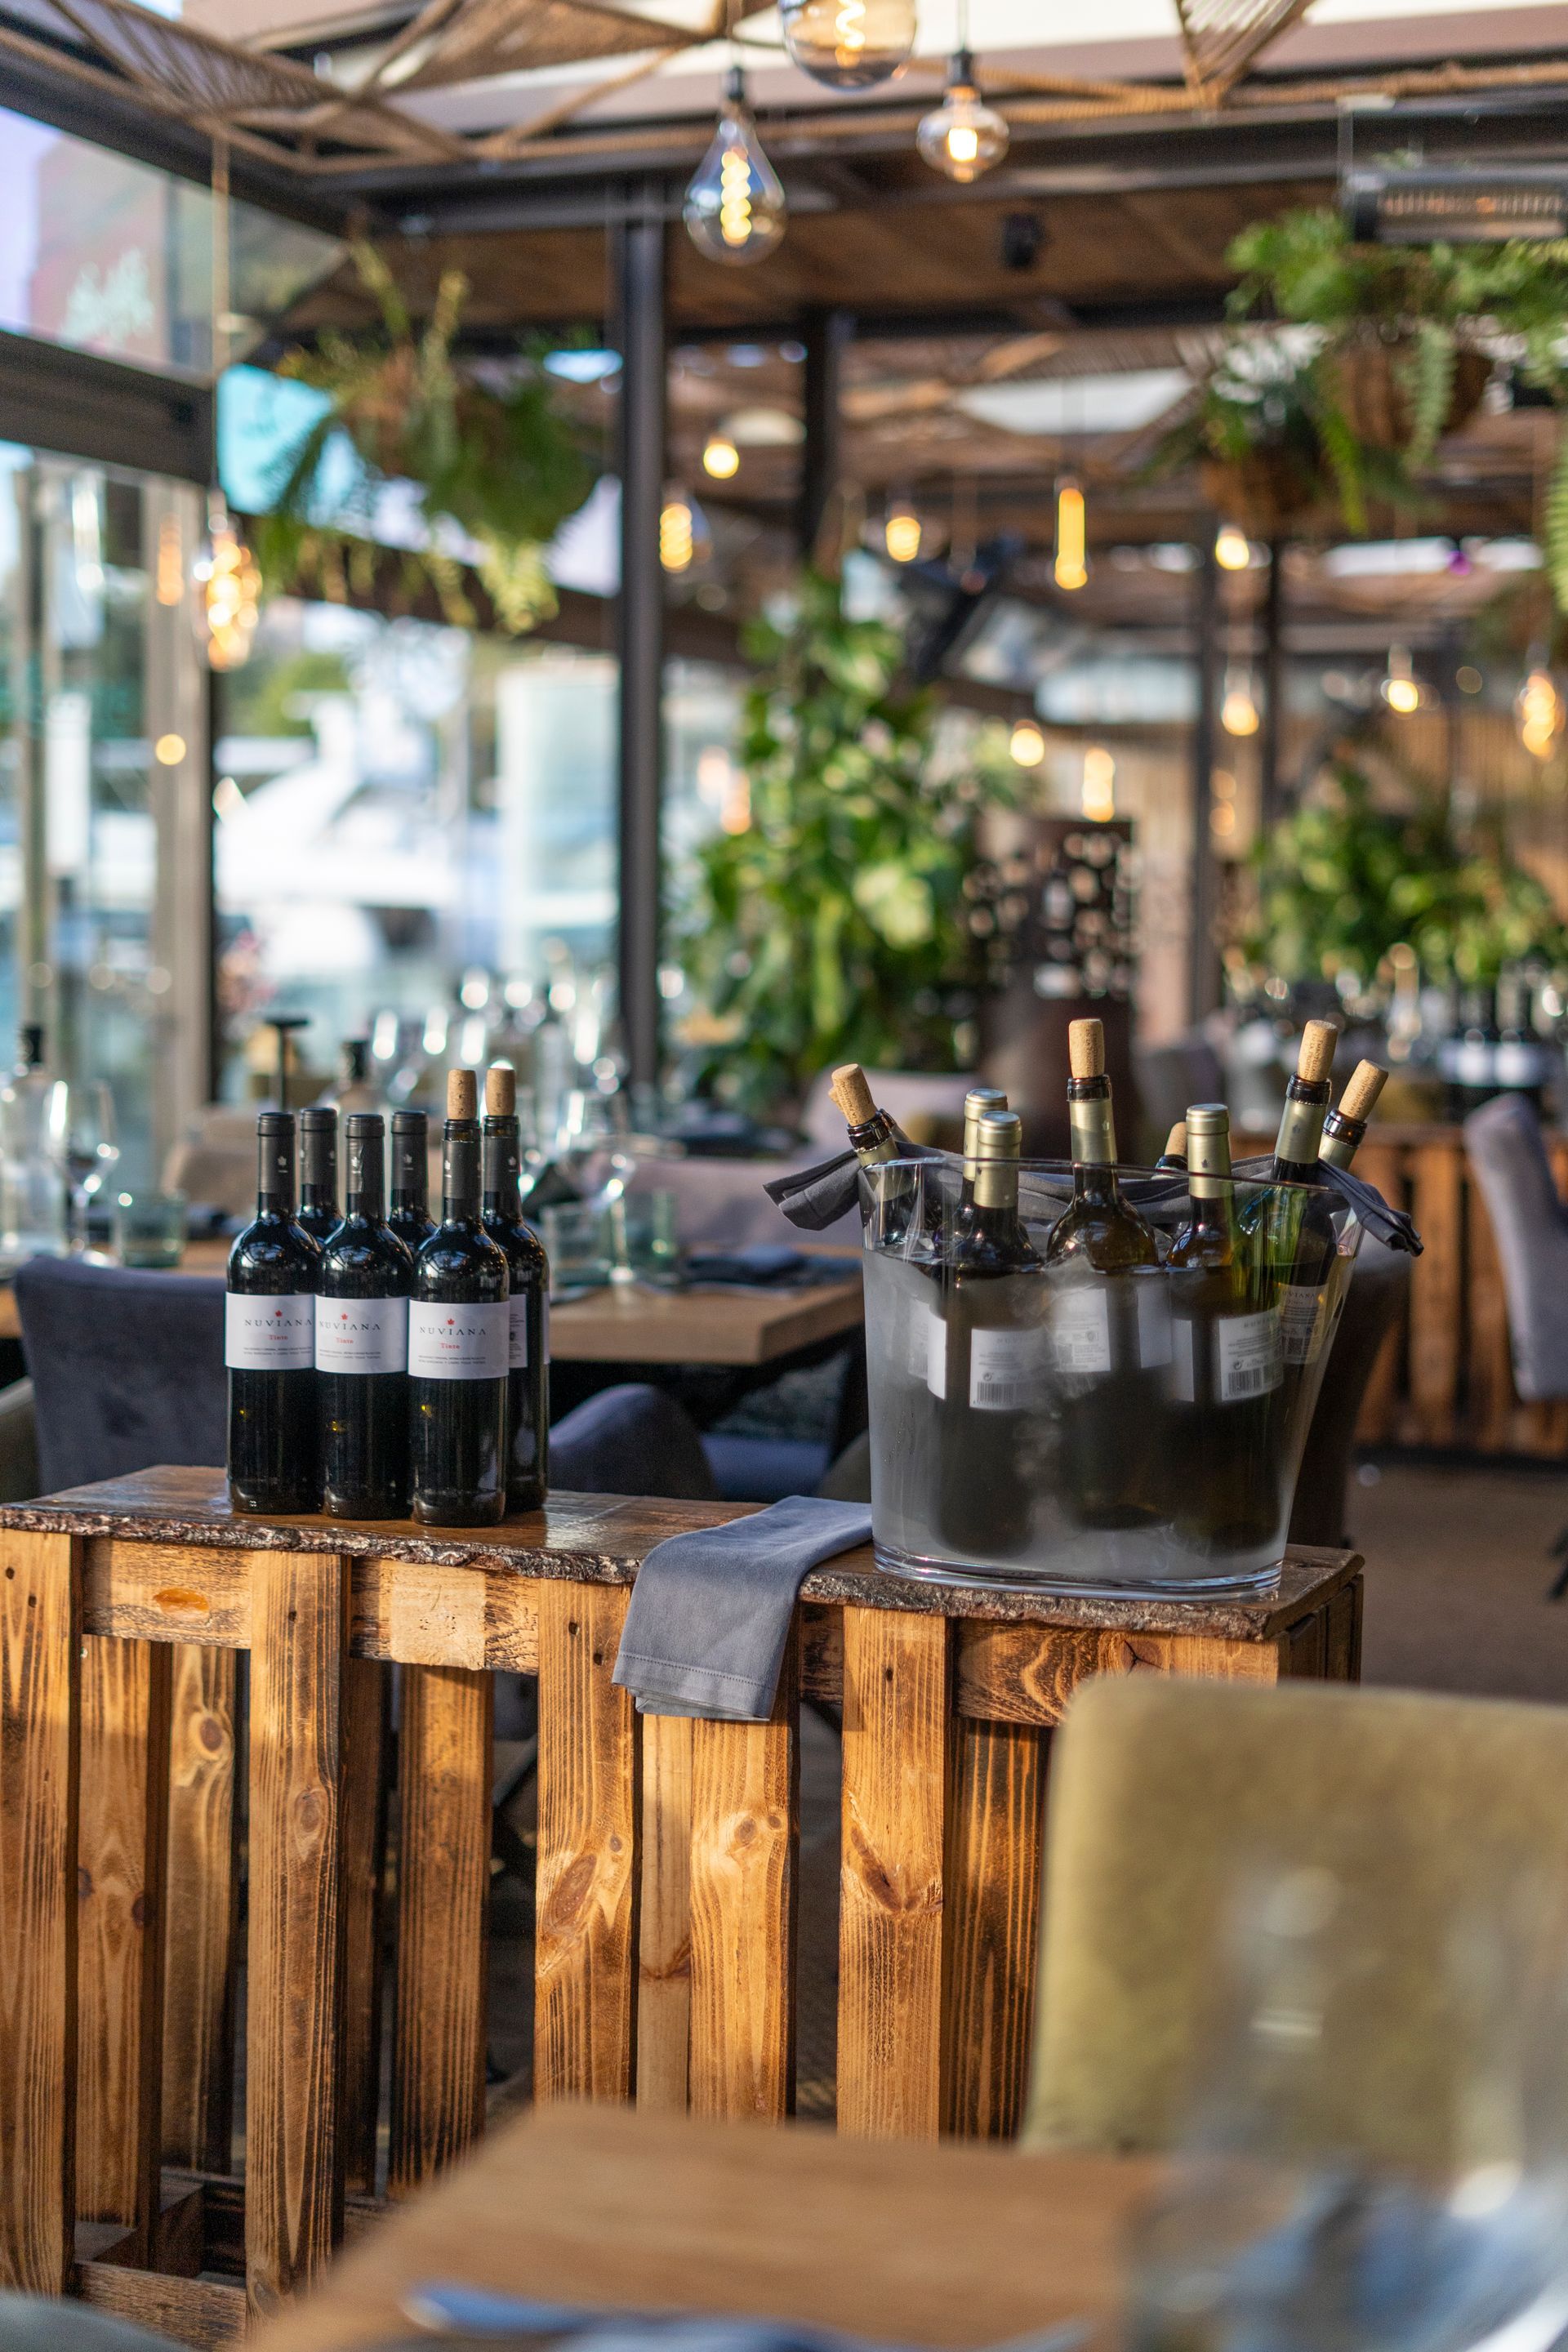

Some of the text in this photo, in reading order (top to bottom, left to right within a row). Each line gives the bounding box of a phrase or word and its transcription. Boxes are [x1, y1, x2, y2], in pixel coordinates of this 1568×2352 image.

[244, 1319, 312, 1327] NUVIANA
[319, 1321, 381, 1330] NUVIANA
[418, 1326, 486, 1335] NUVIANA
